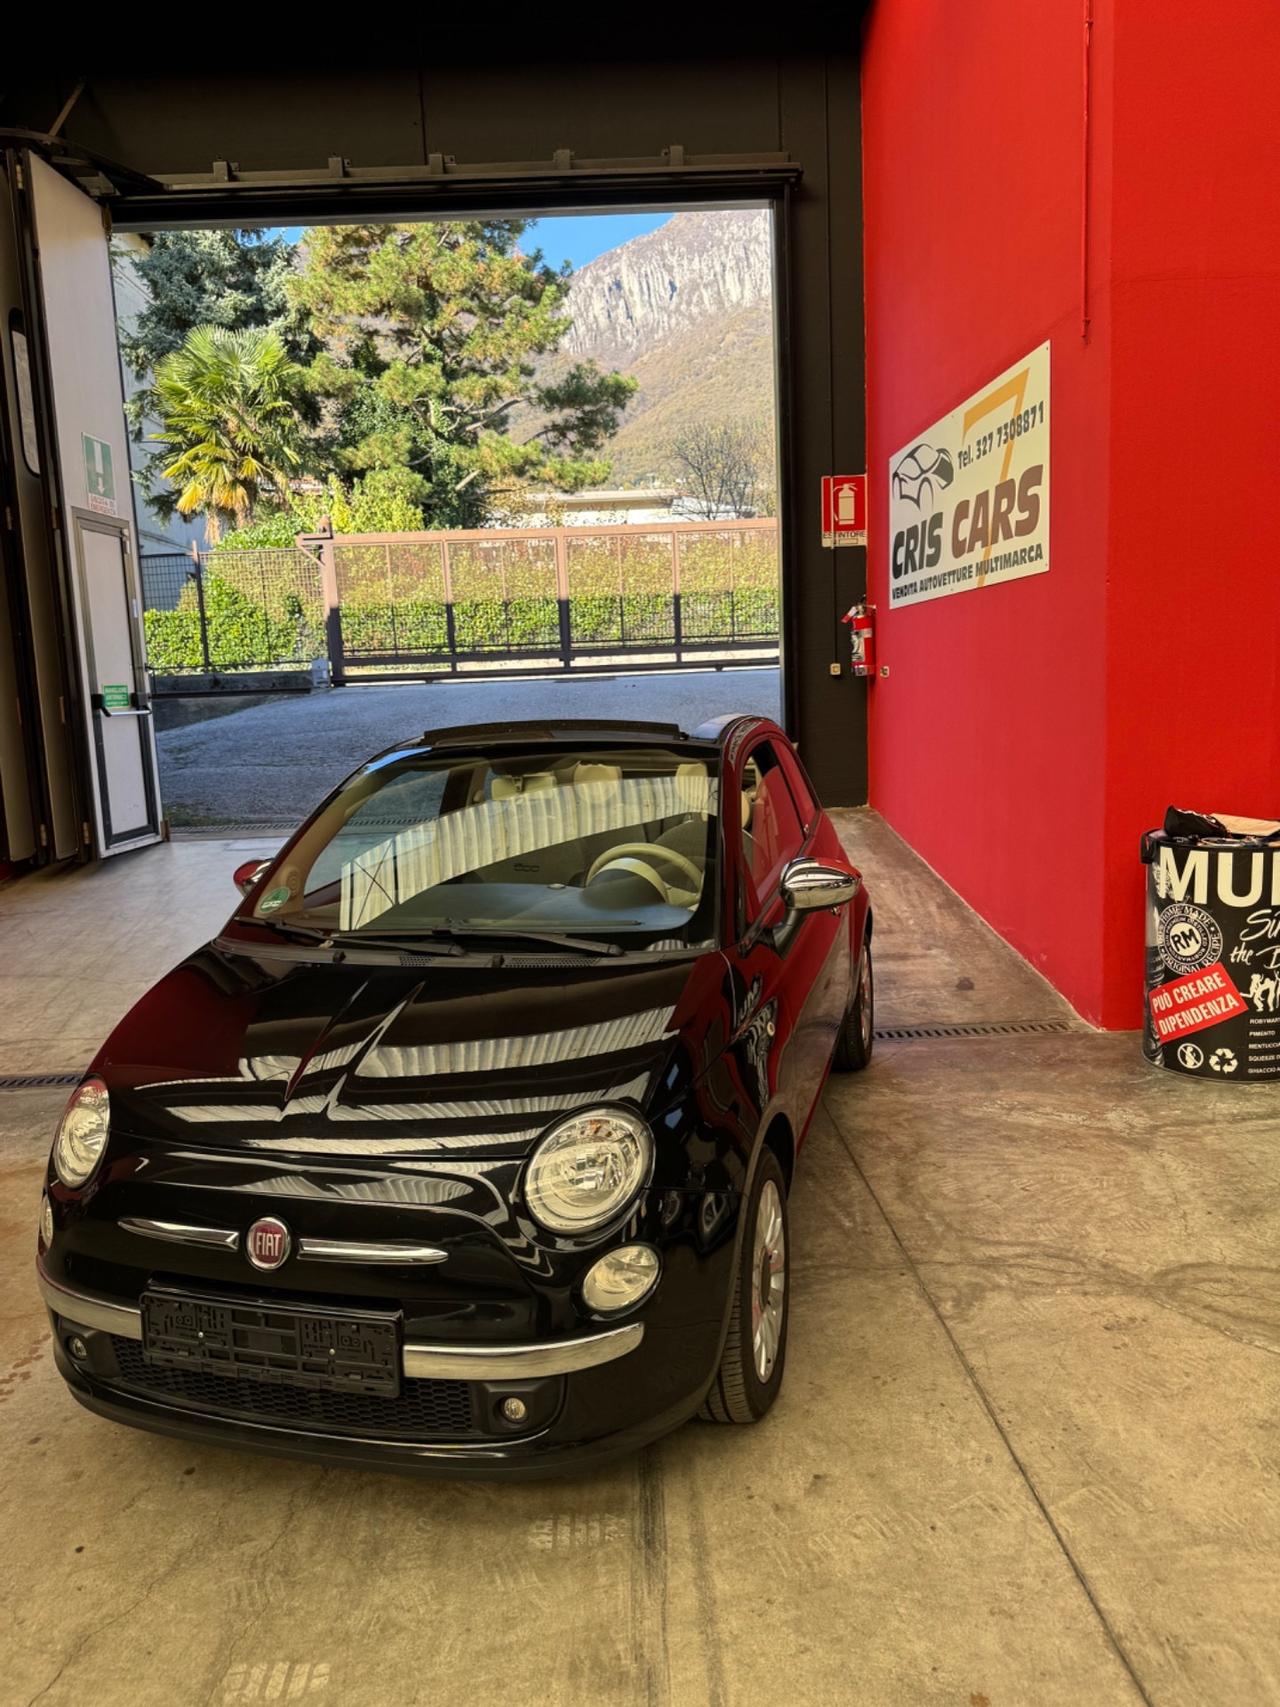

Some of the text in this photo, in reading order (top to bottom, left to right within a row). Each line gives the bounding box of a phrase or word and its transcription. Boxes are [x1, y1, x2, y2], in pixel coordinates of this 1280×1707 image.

[958, 401, 1044, 469] Tel. 327 7308871
[892, 464, 1044, 579] CRIS CARS
[892, 543, 1044, 600] VENDITA AUTOVETTURE MULTIMARCA
[1184, 906, 1211, 928] MADE
[1171, 928, 1200, 952] RM
[1201, 933, 1220, 967] RECIPE
[1230, 942, 1254, 966] the
[1152, 972, 1226, 1013] PUÒ CREARE
[1159, 993, 1239, 1036] DIPENDENZA
[256, 1232, 282, 1257] FIAT
